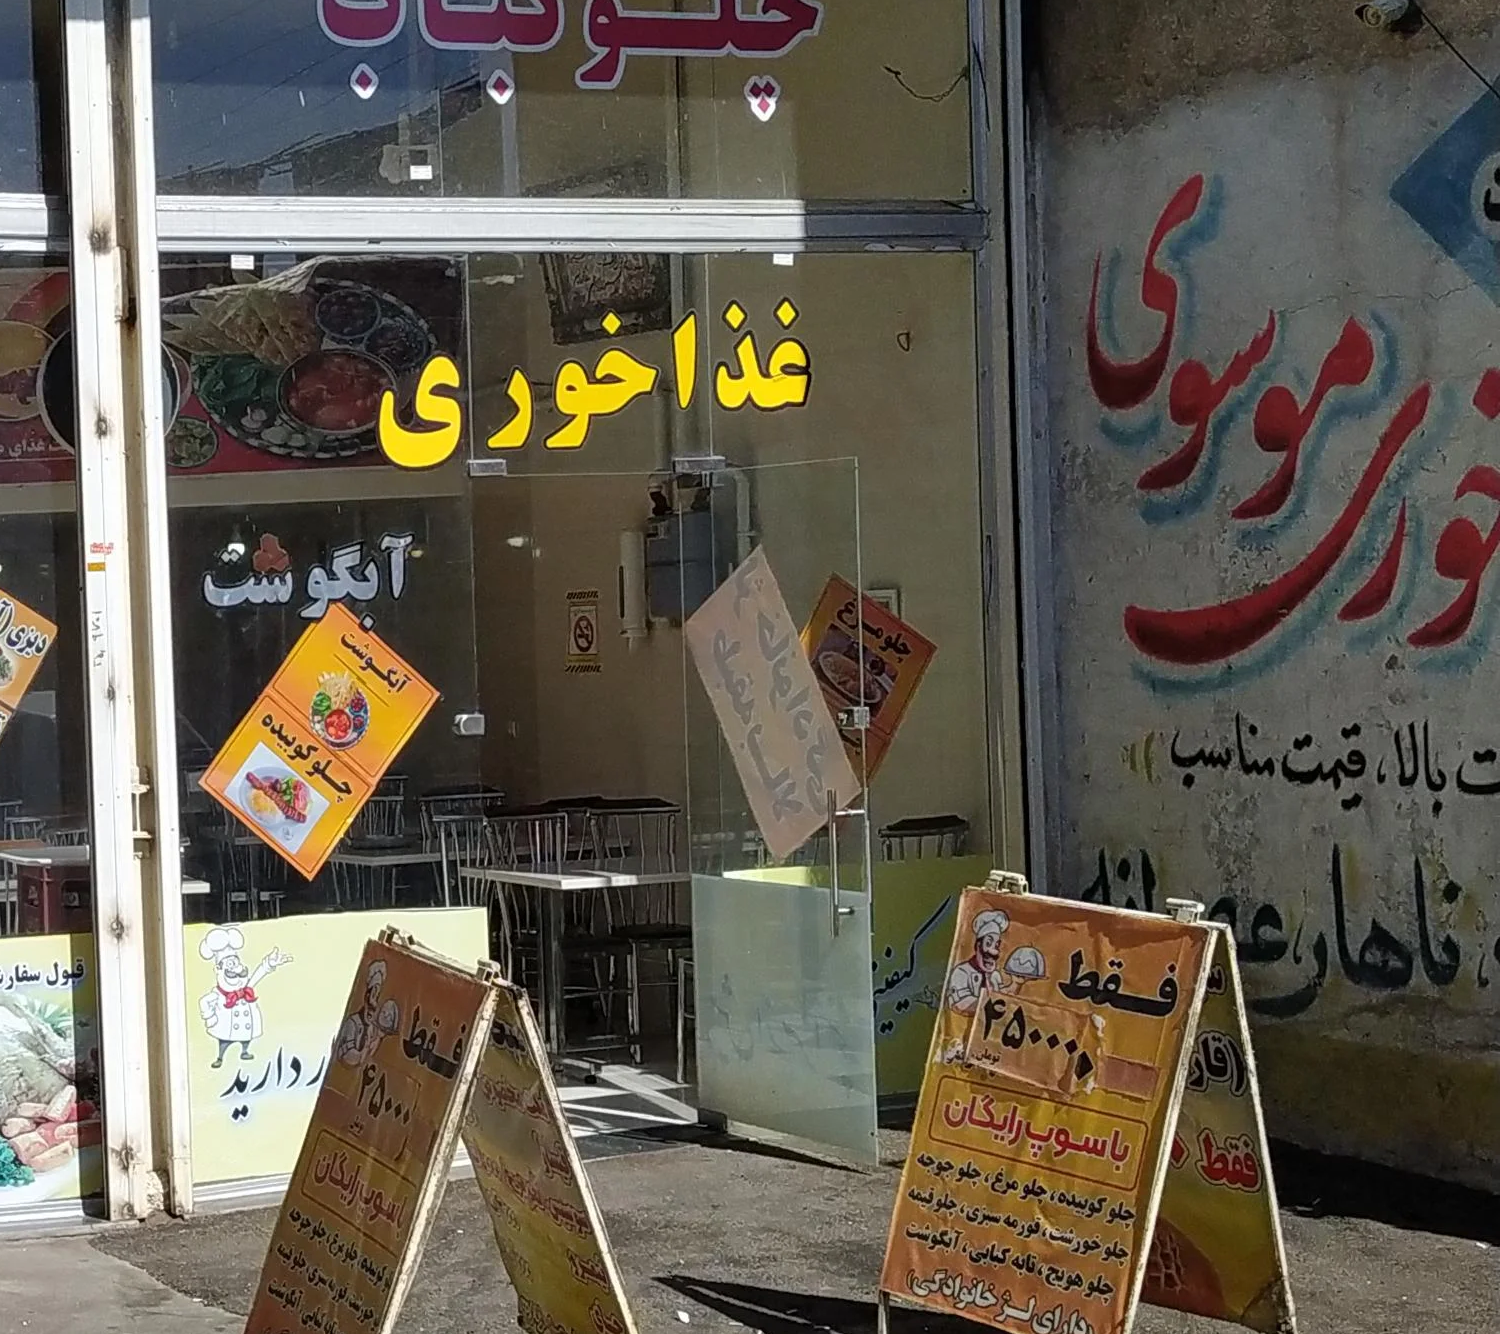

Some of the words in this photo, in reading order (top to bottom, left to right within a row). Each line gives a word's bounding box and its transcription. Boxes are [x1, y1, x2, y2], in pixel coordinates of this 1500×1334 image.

[6, 626, 48, 656] دیزی
[339, 631, 412, 694] آبگوشت
[260, 713, 318, 760] کوبیده
[45, 957, 86, 990] قبول
[1057, 948, 1180, 1019] فقط
[402, 1002, 468, 1080] فقط
[942, 1093, 1025, 1147] رایگان
[1025, 1124, 1109, 1159] سوپ
[916, 1151, 954, 1178] جوجه
[954, 1160, 982, 1186] چلو
[1196, 1127, 1262, 1194] فقط
[907, 1185, 935, 1209] قیمه
[932, 1191, 958, 1215] چلو
[1019, 1177, 1048, 1205] چلو
[1105, 1201, 1136, 1229] چلو
[904, 1222, 964, 1254] آبگوشت
[1101, 1240, 1130, 1267] چلو
[1011, 1252, 1037, 1276] تابه
[1083, 1273, 1115, 1304] چلو
